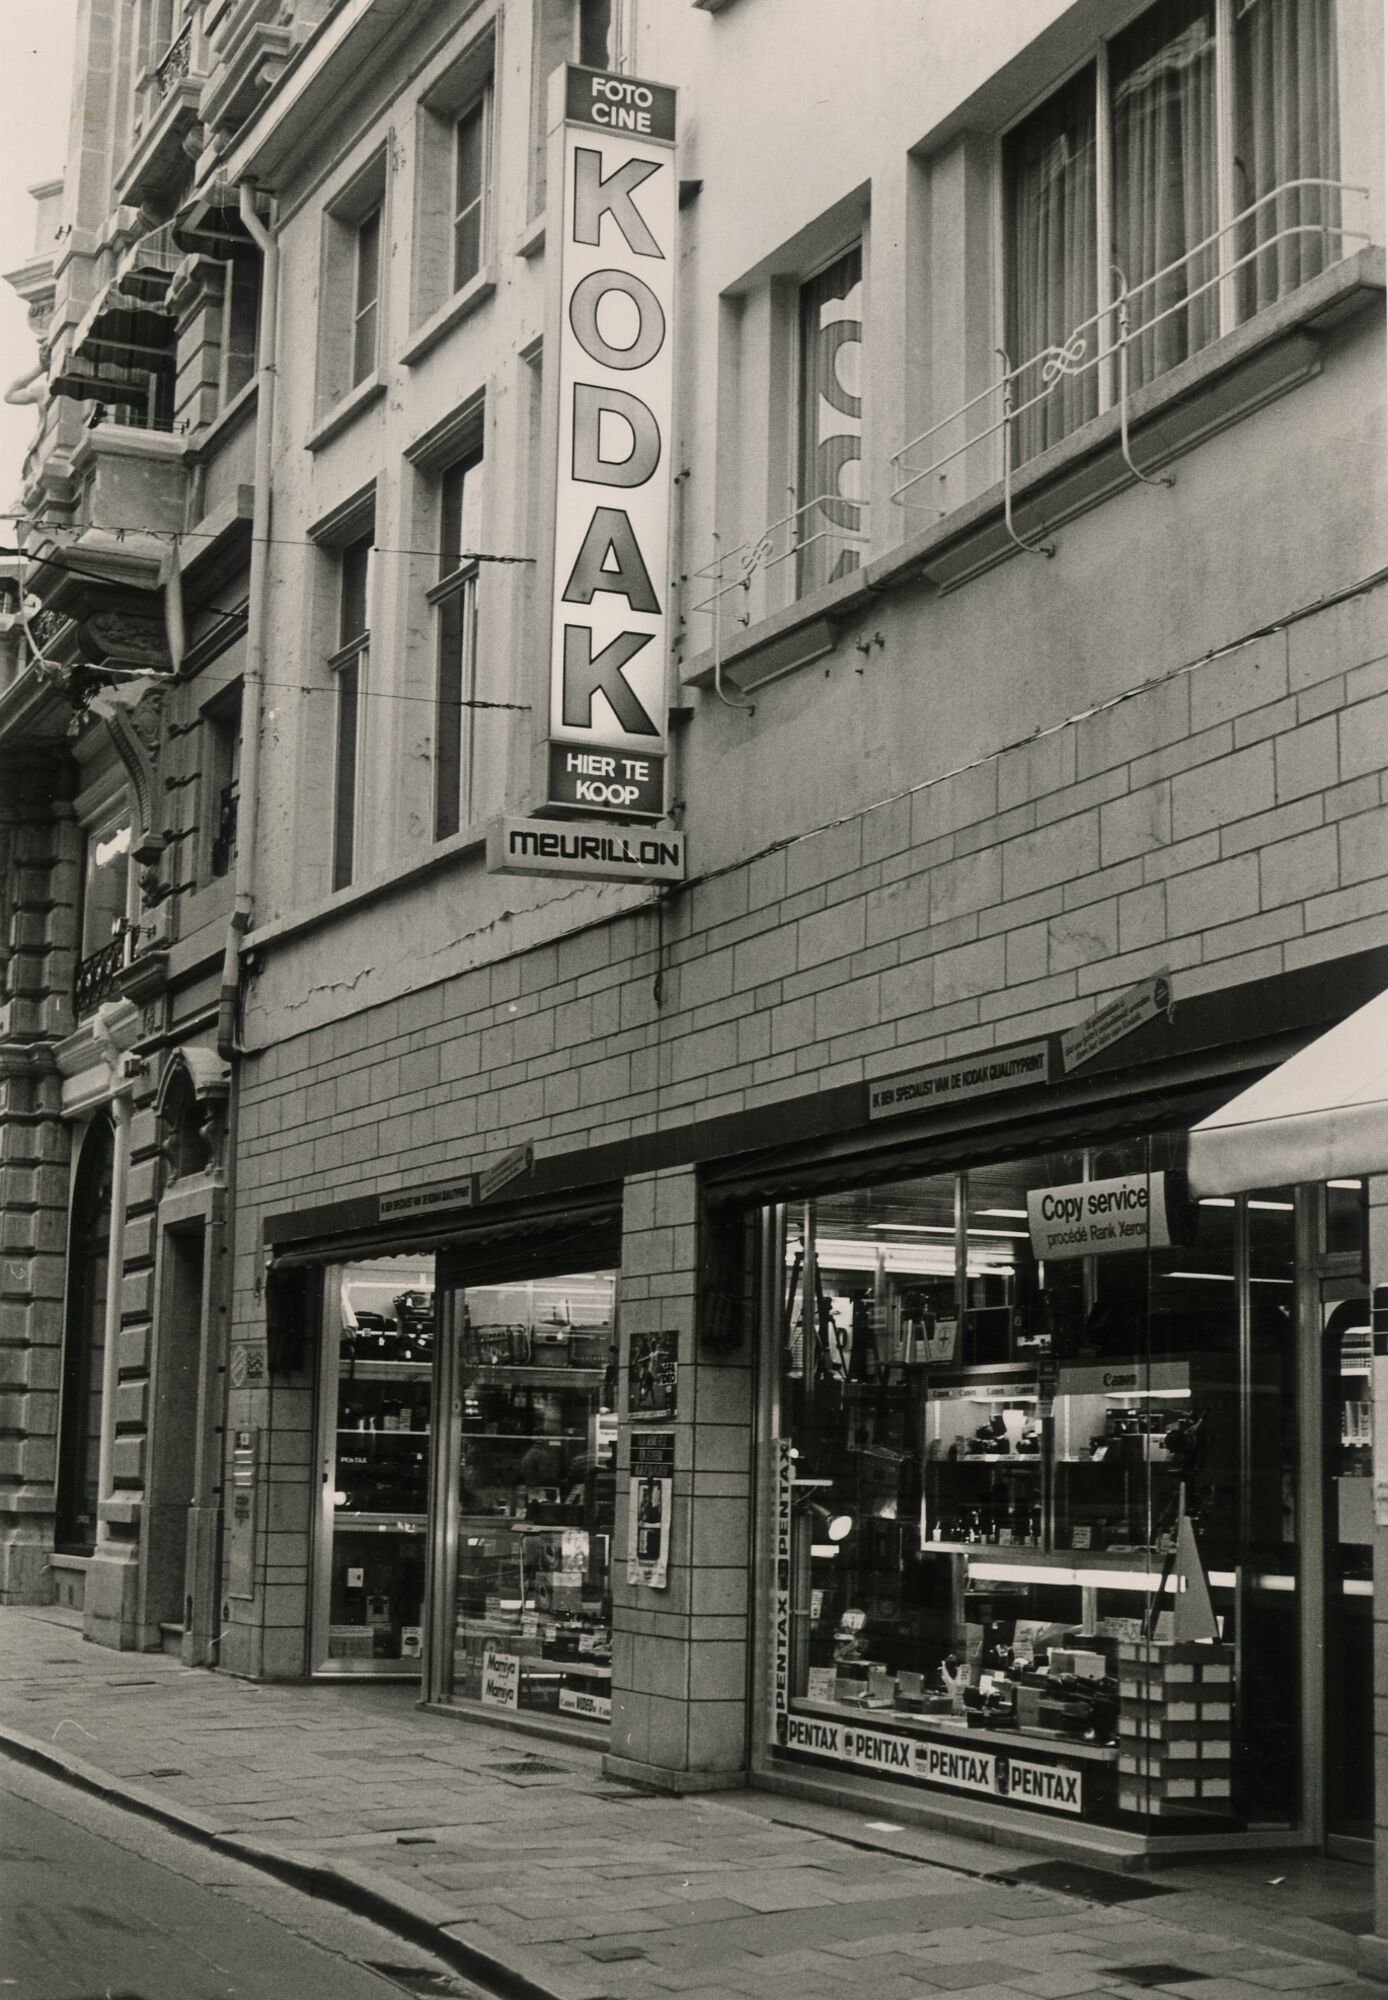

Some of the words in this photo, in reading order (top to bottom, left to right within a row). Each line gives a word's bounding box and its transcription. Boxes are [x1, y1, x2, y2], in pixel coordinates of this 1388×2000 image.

[592, 77, 653, 107] FOTO
[592, 103, 652, 133] CINE
[561, 146, 666, 737] KODAK
[566, 752, 615, 778] HIER
[621, 759, 649, 782] TE
[575, 779, 640, 805] KOOP
[951, 1072, 962, 1090] DE
[962, 1065, 989, 1088] KODAK
[1041, 1194, 1083, 1223] Copy
[1088, 1184, 1148, 1215] service
[1090, 1223, 1116, 1241] Rank
[1103, 1373, 1137, 1388] Canon
[779, 1442, 790, 1557] PENTAX
[776, 1597, 788, 1711] PENTAX
[788, 1722, 838, 1752] PENTAX
[856, 1731, 910, 1768] PENTAX
[930, 1748, 989, 1785] PENTAX
[1011, 1766, 1078, 1804] PENTAX
